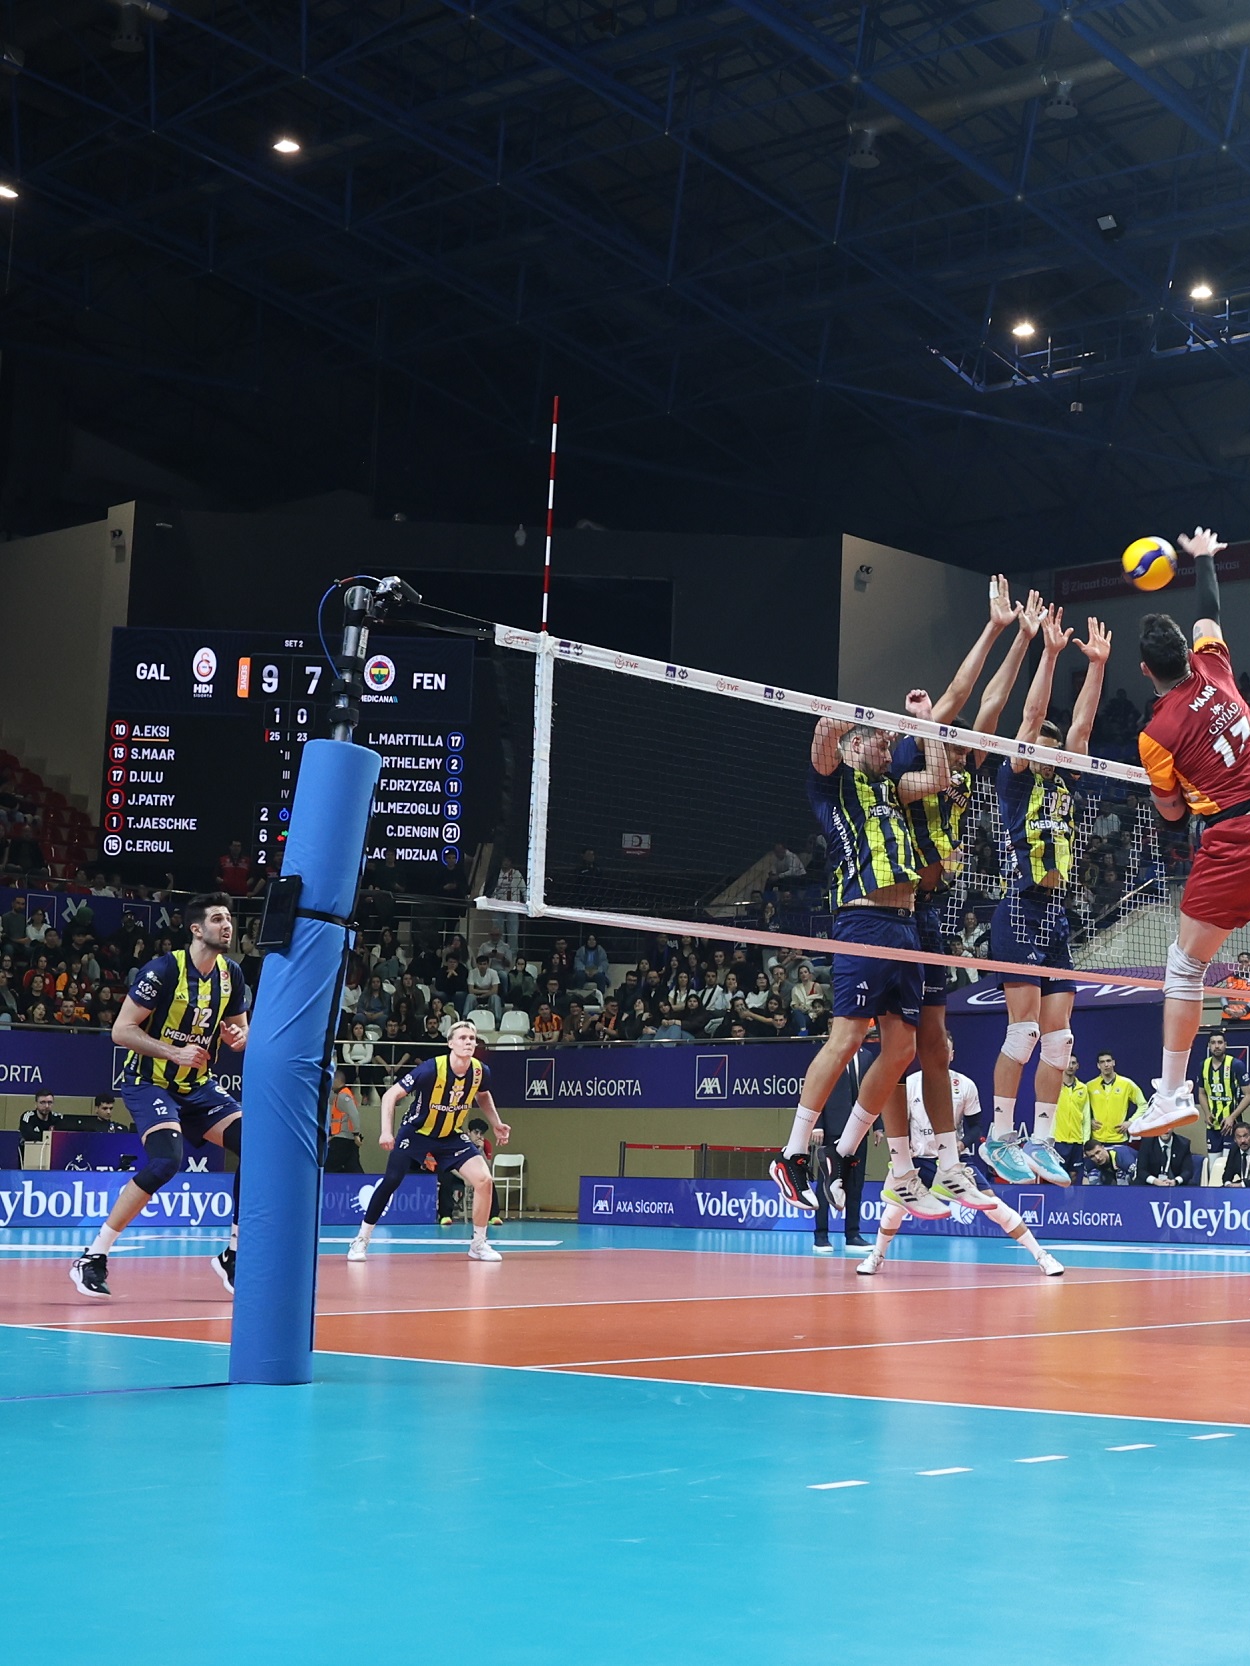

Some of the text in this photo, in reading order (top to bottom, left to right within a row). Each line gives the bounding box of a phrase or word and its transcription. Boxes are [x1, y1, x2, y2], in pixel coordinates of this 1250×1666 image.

[284, 640, 303, 648] SET 2
[136, 662, 170, 680] GAL
[262, 664, 278, 693] 9
[305, 666, 322, 694] 7
[412, 673, 446, 690] FEN
[193, 684, 213, 693] HDI
[1189, 684, 1217, 712] MAAR
[274, 707, 280, 723] 1
[297, 708, 307, 724] 0
[115, 724, 126, 736] 10
[132, 725, 170, 738] A.EKSI
[270, 732, 280, 741] 25
[297, 732, 308, 742] 23
[368, 733, 443, 747] L.MARTTILLA
[450, 736, 461, 747] 17
[113, 747, 124, 759] 13
[130, 748, 175, 761] S.MAAR
[382, 756, 442, 770] RTHELEMY
[450, 759, 458, 770] 2
[112, 770, 123, 781] 17
[129, 771, 164, 783] D.ULU
[380, 779, 441, 792] F.DRZYZGA
[449, 782, 458, 792] 11
[112, 793, 119, 804] 9
[128, 794, 175, 806] J.PATRY
[1050, 792, 1070, 816] 13
[260, 807, 268, 821] 2
[373, 801, 440, 815] ULMEZOGLU
[447, 805, 458, 815] 13
[112, 816, 117, 828] 1
[126, 816, 197, 830] T.JAESCHKE
[259, 829, 268, 842] 6
[386, 825, 439, 838] C.DENGIN
[446, 828, 456, 838] 21
[108, 839, 119, 850] 15
[125, 840, 173, 853] C.ERGUL
[257, 850, 266, 864] 2
[856, 994, 866, 1006] 11
[192, 1008, 212, 1028] 12
[526, 1077, 642, 1096] AXA AXA SİGORTA
[696, 1077, 722, 1095] AXA
[732, 1078, 759, 1095] AXA
[1211, 1083, 1224, 1092] 20
[449, 1091, 465, 1103] 17
[155, 1106, 169, 1116] 12
[593, 1199, 674, 1214] AXA AXA SİGORTA
[1021, 1210, 1123, 1226] AXA AXA SİGORTA
